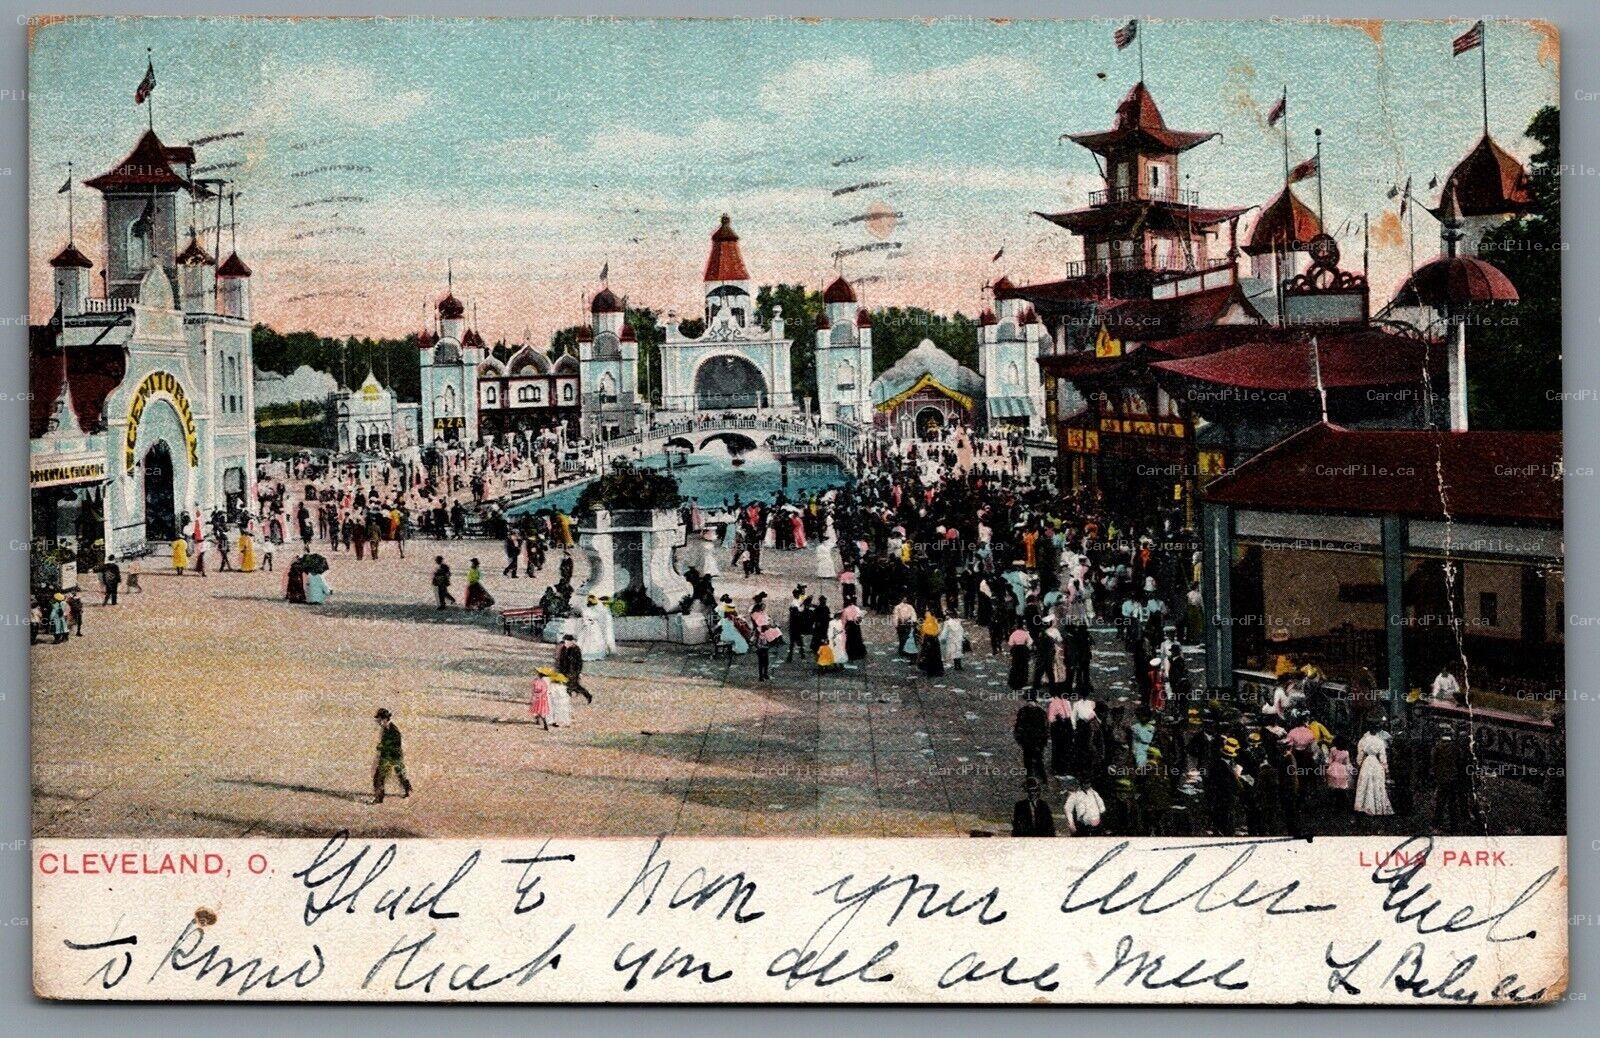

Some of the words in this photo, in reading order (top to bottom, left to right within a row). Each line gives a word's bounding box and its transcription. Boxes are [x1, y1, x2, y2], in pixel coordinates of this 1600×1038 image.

[39, 853, 232, 878] CLEVELAND,
[247, 853, 276, 875] O.
[1358, 851, 1427, 868] LUNA
[1442, 851, 1514, 868] PARK.
